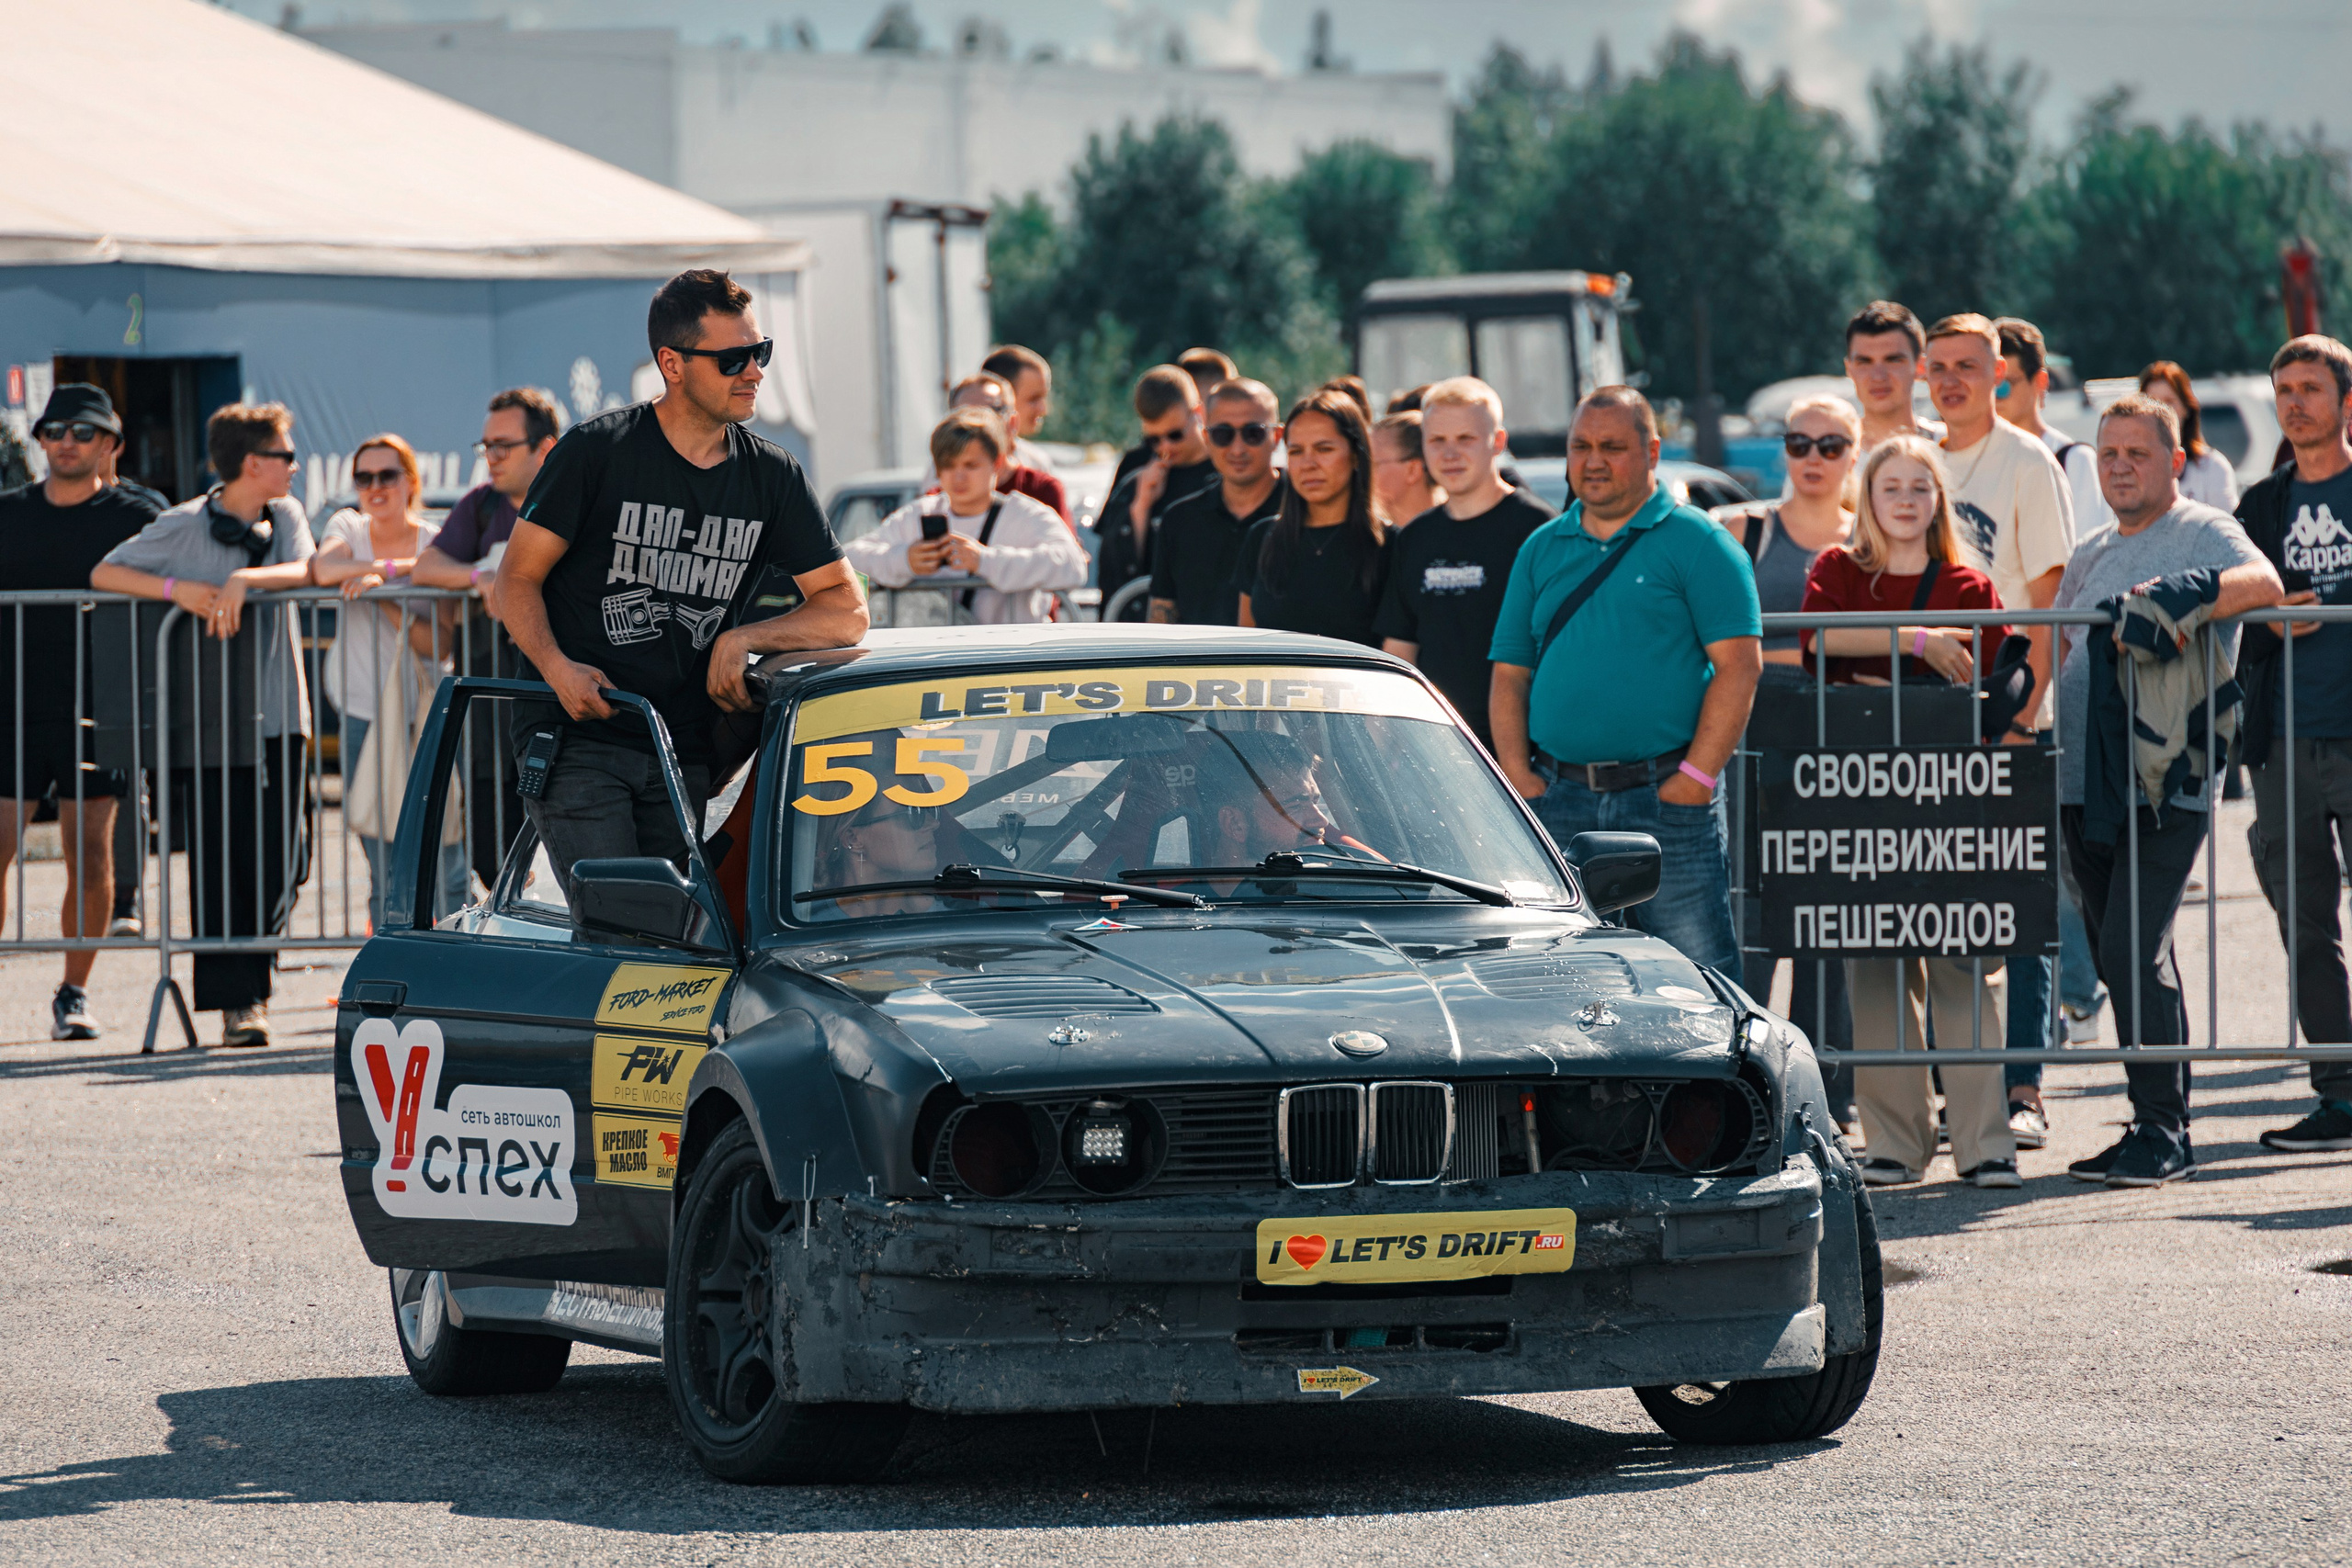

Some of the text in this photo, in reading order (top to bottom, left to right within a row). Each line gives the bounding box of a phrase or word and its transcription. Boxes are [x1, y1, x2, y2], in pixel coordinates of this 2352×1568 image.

[920, 679, 1355, 721] LET'S DRIFT
[791, 738, 970, 817] 55
[1793, 751, 2012, 806] СВОБОДНОЕ
[1761, 827, 2047, 882] ПЕРЕДВИЖЕНИЕ
[1794, 902, 2017, 956] ПЕШЕХОДОВ
[608, 976, 719, 1012] FORD-MARKET
[617, 1045, 684, 1085] PW
[615, 1087, 683, 1106] PIPE WORKS
[461, 1107, 561, 1129] сеть автошкол
[603, 1129, 649, 1152] КРЕПКОЕ
[609, 1151, 648, 1174] МАСЛО
[657, 1167, 676, 1179] ВМП
[1269, 1240, 1283, 1265] I
[1329, 1235, 1429, 1264] LET'S
